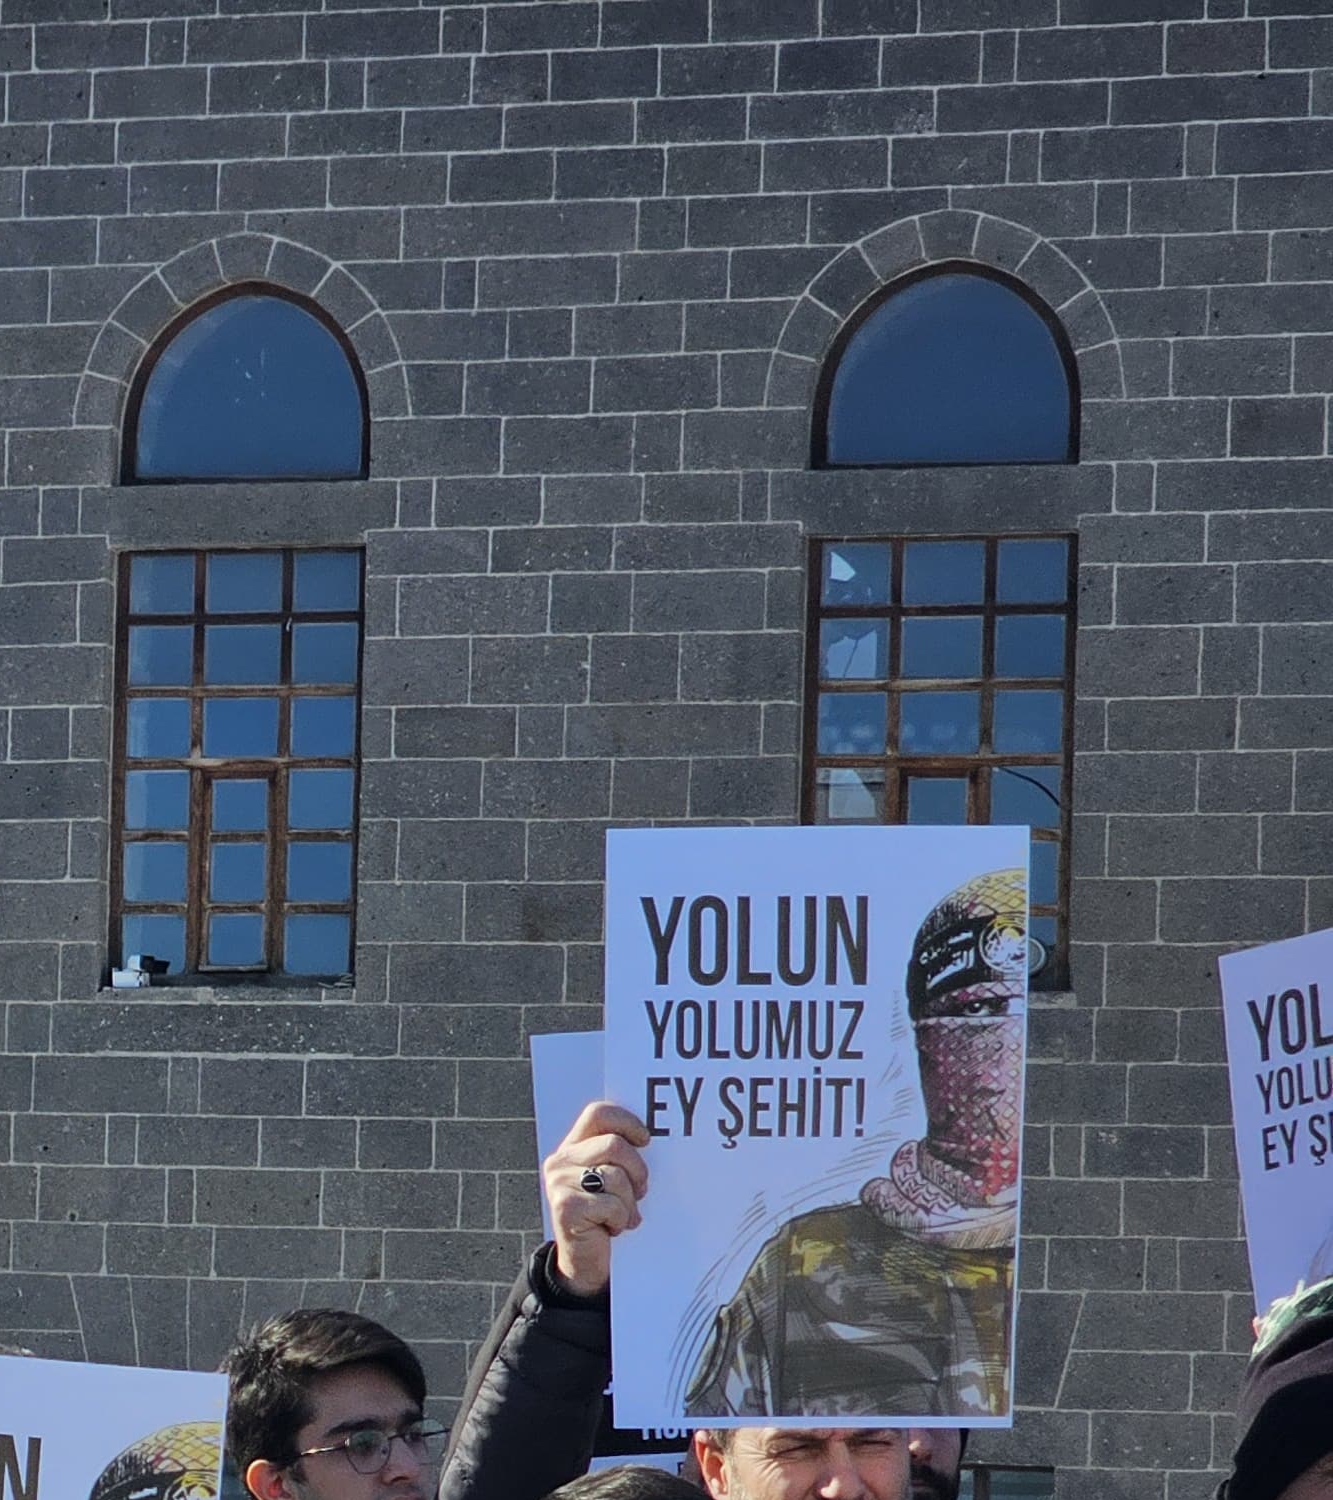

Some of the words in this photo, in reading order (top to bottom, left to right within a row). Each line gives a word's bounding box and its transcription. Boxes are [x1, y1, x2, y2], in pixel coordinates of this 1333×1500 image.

[641, 895, 869, 986] YOLUN
[645, 999, 864, 1060] YOLUMUZ
[646, 1077, 704, 1137] EY
[717, 1066, 865, 1149] ŞEHİT!
[1262, 1119, 1298, 1171] EY
